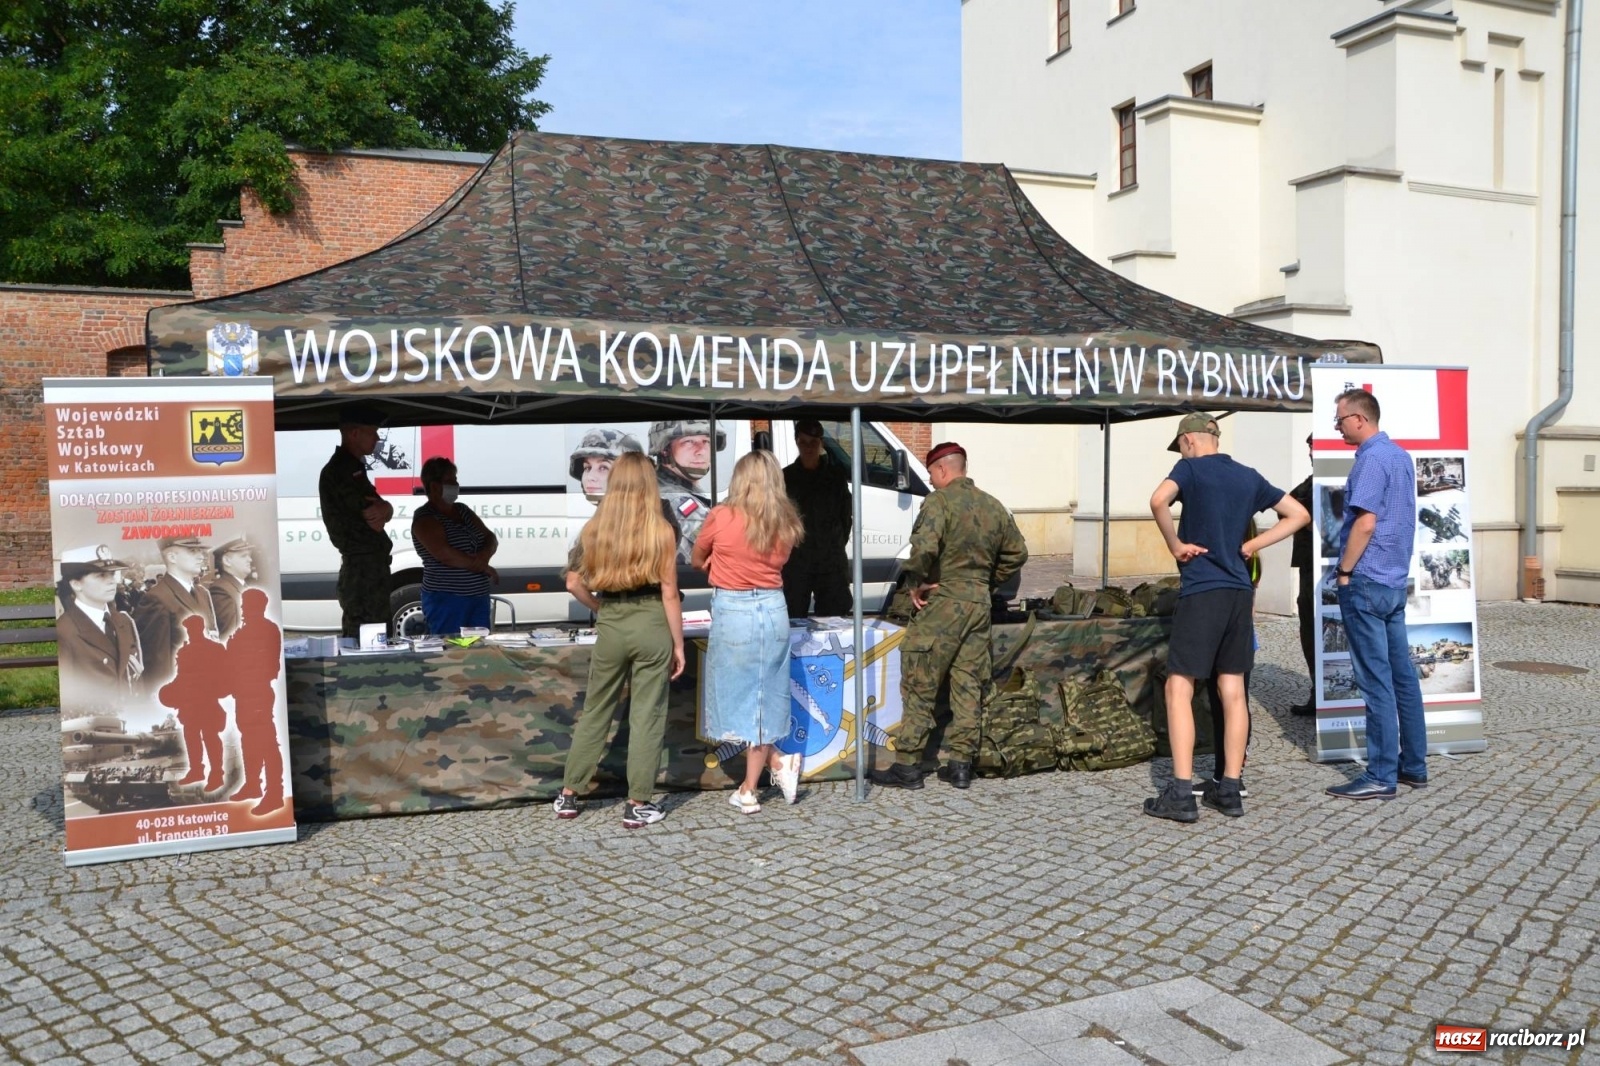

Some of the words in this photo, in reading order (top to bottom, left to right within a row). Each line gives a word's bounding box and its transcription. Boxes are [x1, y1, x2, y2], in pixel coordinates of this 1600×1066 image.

[284, 325, 583, 384] WOJSKOWA
[598, 330, 836, 392] KOMENDA
[849, 337, 1100, 396] UZUPEŁNIEŃ
[1110, 347, 1147, 394] W
[1157, 349, 1307, 400] RYBNIKU
[55, 407, 160, 423] Wojewódzki
[57, 425, 105, 440] Sztab
[57, 443, 144, 459] Wojskowy
[59, 464, 70, 474] w
[74, 460, 155, 474] Katowicach
[60, 493, 111, 509] DOŁĄCZ
[115, 493, 133, 505] DO
[136, 486, 268, 504] PROFESJONALISTÓW
[97, 508, 149, 523] ZOSTAŃ
[151, 505, 235, 521] ŻOŁNIERZEM
[473, 505, 523, 519] IĘCEJ
[122, 524, 213, 540] ZAWODOWYM
[136, 816, 175, 830] 40-028
[178, 811, 229, 825] Katowice
[156, 827, 213, 841] Francuska
[215, 824, 229, 836] 30
